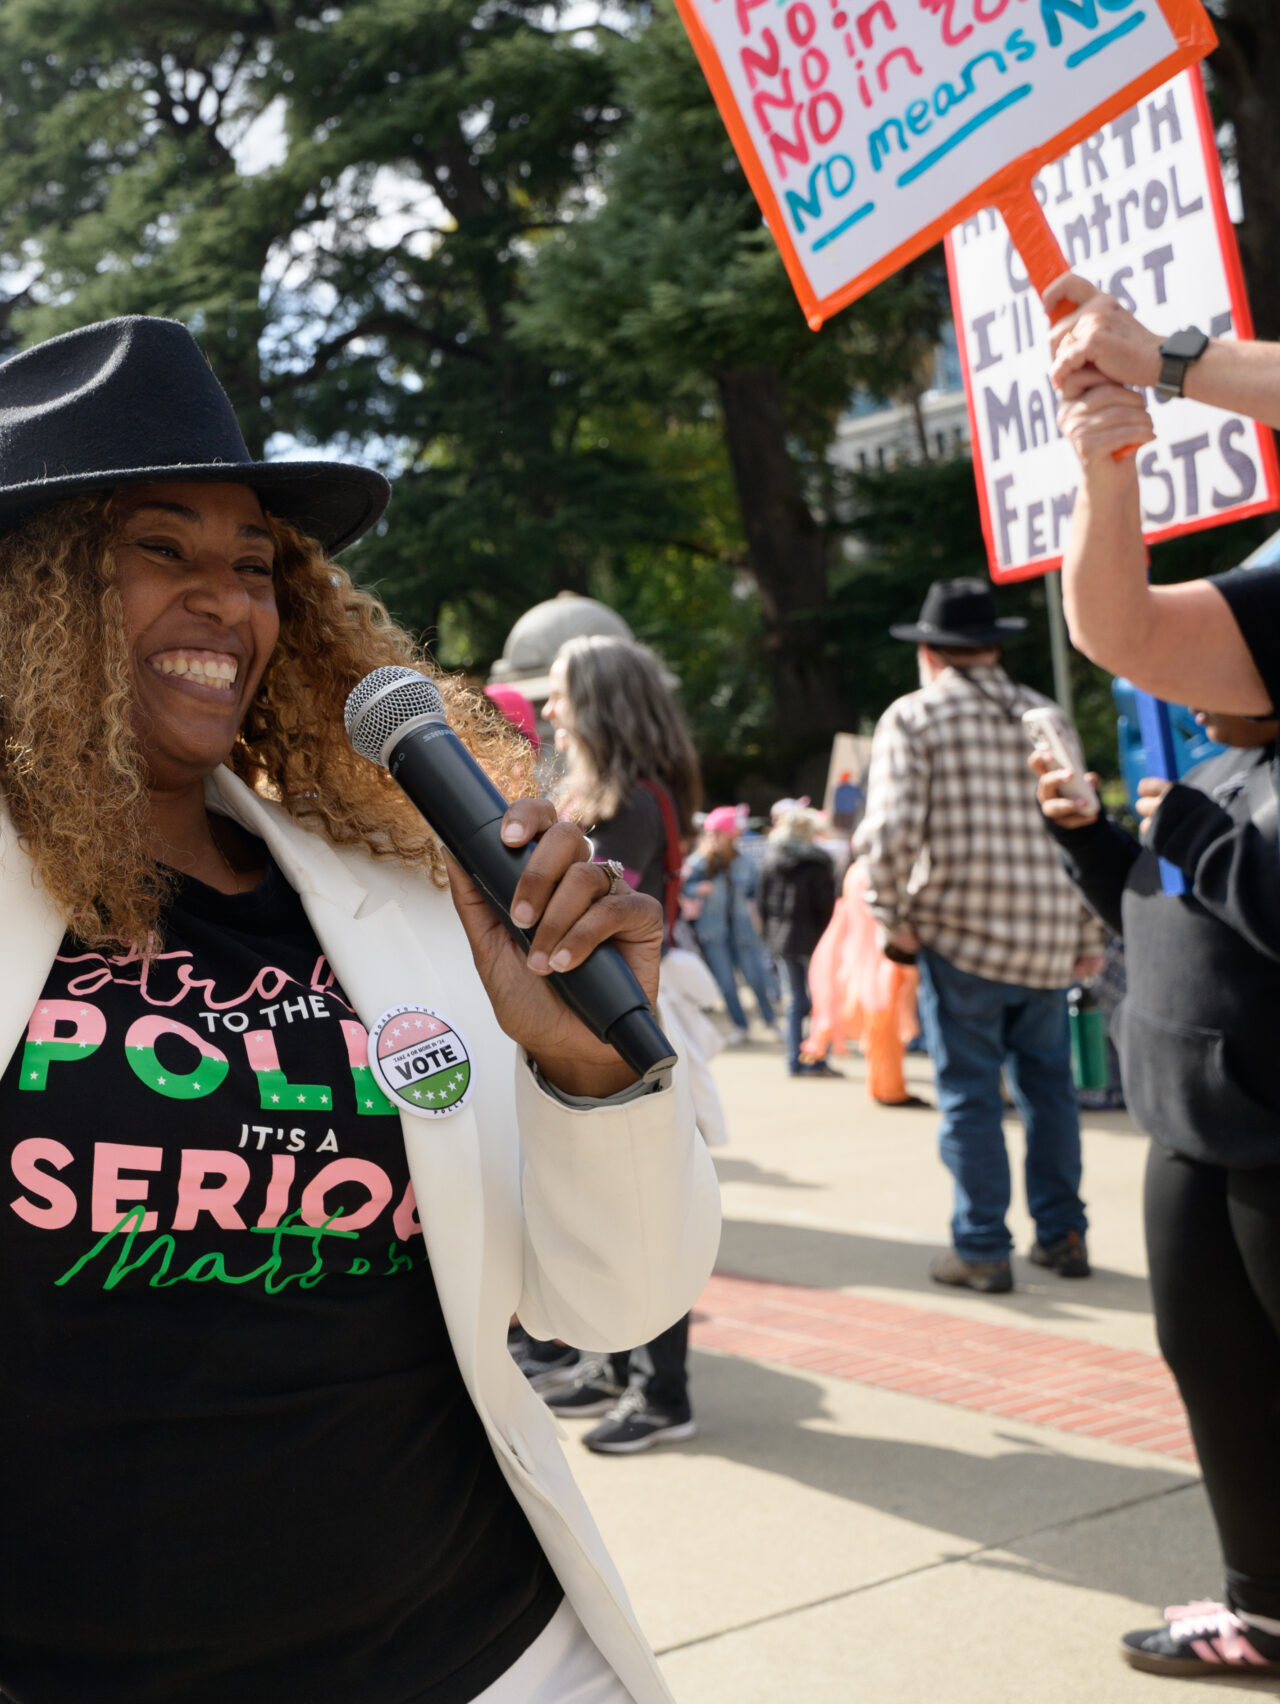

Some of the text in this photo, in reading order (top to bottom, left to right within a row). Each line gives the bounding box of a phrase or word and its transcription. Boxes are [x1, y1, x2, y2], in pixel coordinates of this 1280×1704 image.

[854, 46, 924, 108] in
[868, 28, 1036, 172] means
[198, 995, 331, 1033] TO THE
[18, 998, 400, 1116] POLL
[394, 1044, 458, 1081] VOTE
[238, 1123, 340, 1154] IT'S A
